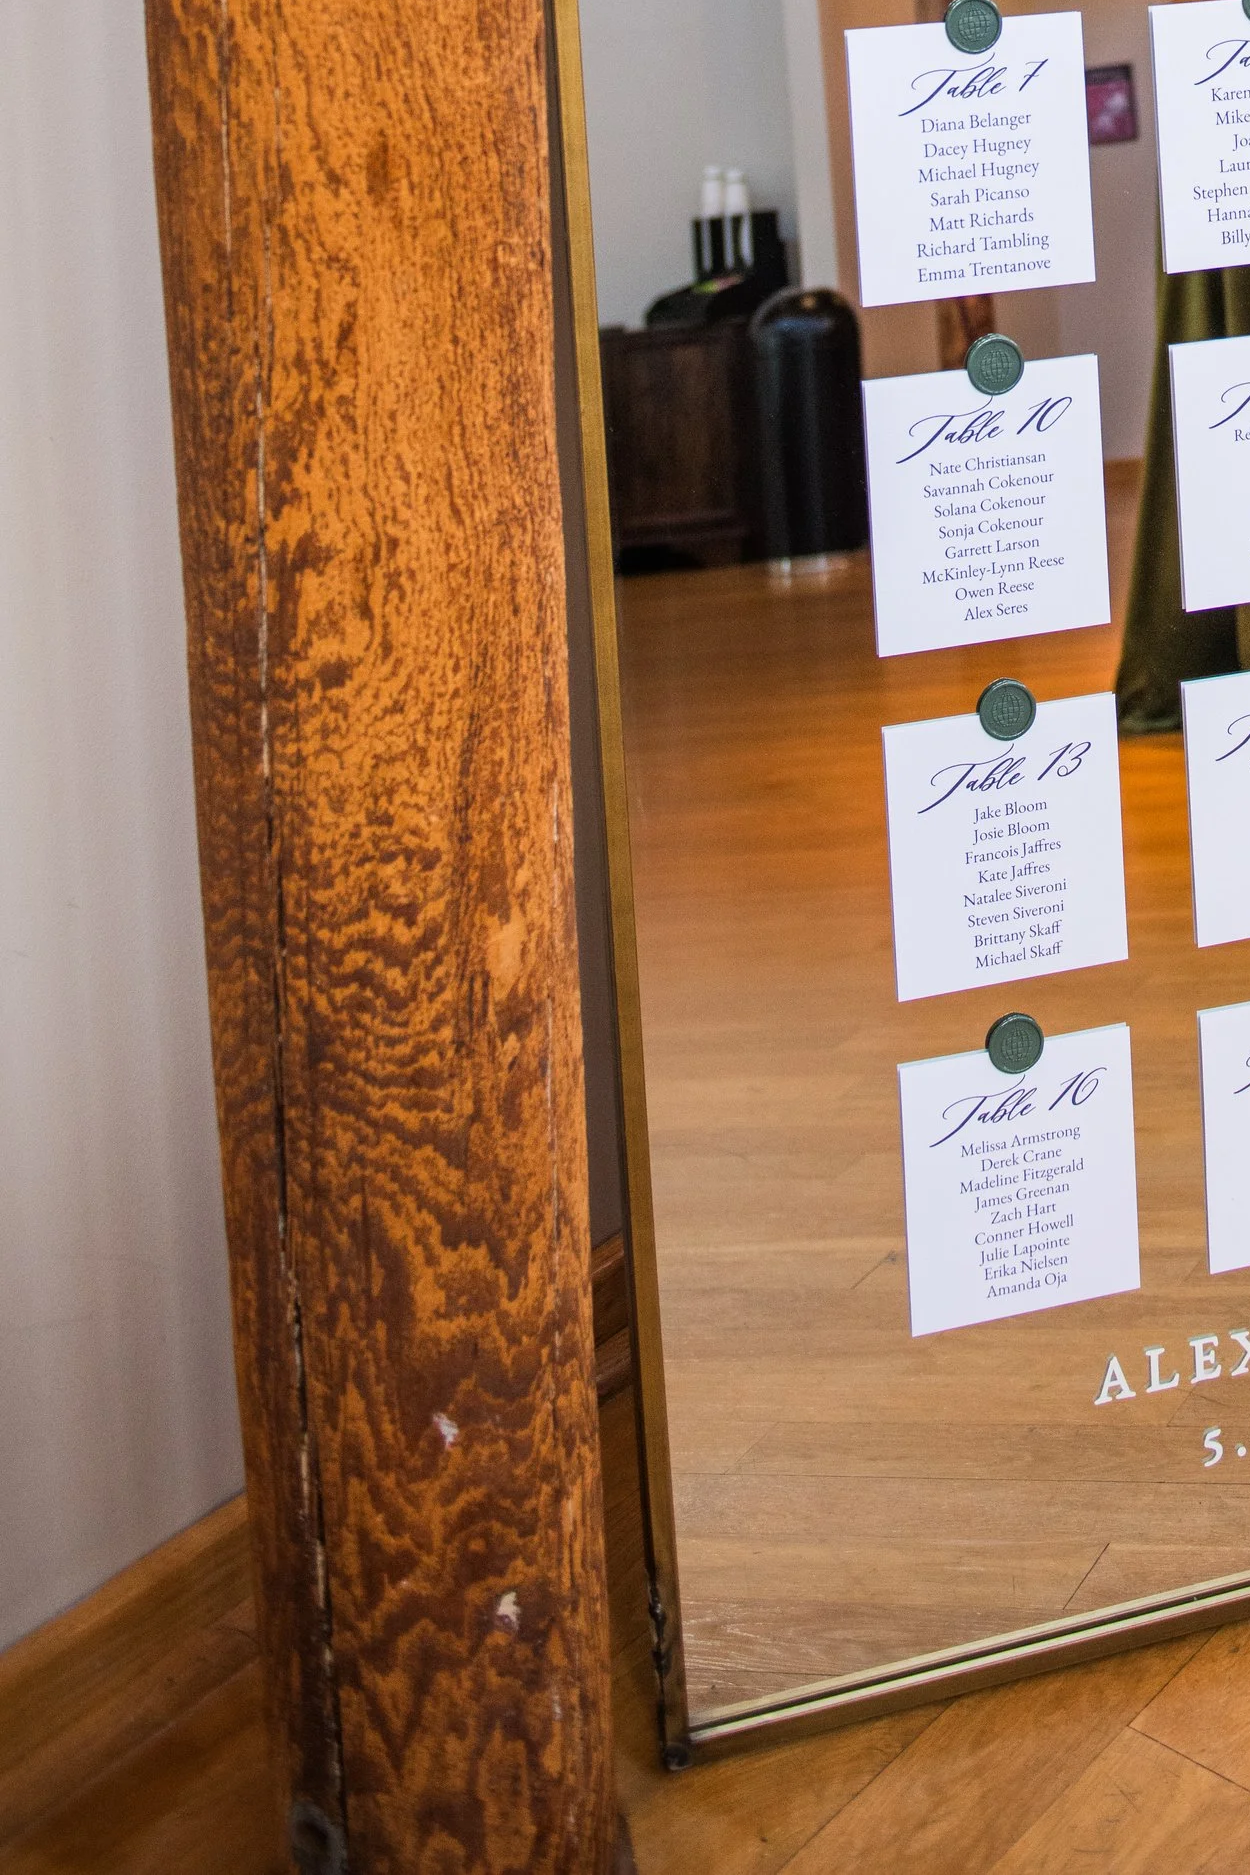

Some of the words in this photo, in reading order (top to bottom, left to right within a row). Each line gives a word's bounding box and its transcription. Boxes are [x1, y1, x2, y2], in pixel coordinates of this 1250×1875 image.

[897, 52, 1008, 118] Table
[1018, 58, 1049, 93] 7
[920, 118, 965, 134] Diana
[969, 112, 1032, 131] Belanger
[1215, 109, 1250, 126] Mike
[930, 188, 970, 207] Sarah
[974, 187, 1030, 203] Picanso
[917, 237, 976, 259] Richard
[979, 232, 1050, 251] Tambling
[895, 394, 1006, 465] Table
[1016, 396, 1073, 436] 10
[923, 477, 985, 499] Savannah
[988, 473, 1055, 490] Cokenour
[944, 544, 993, 560] Garrett
[995, 538, 1040, 553] Larson
[963, 606, 993, 622] Alex
[996, 602, 1029, 617] Seres
[916, 742, 1027, 815] Table
[1036, 741, 1092, 782] 13
[972, 805, 1002, 825] Jake
[1004, 801, 1048, 817] Bloom
[963, 888, 1012, 908] Natalee
[1015, 878, 1067, 899] Siveroni
[975, 946, 1027, 969] Michael
[1029, 939, 1064, 959] Skaff
[928, 1073, 1038, 1149] Table
[1047, 1066, 1108, 1112] 16
[961, 1140, 1007, 1158] Melissa
[1010, 1126, 1081, 1148] Armstrong
[974, 1195, 1013, 1214] James
[1015, 1183, 1070, 1201] Greenan
[990, 1206, 1022, 1225] Zach
[1026, 1203, 1057, 1218] Hart
